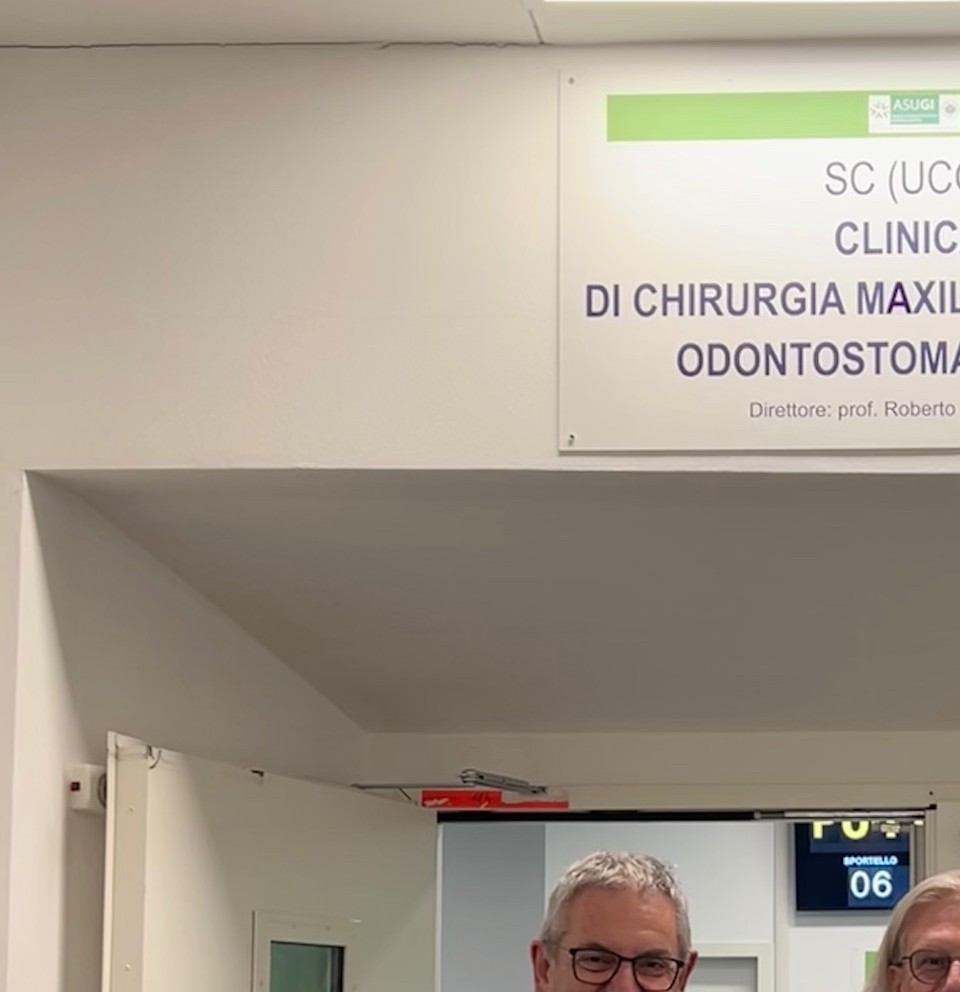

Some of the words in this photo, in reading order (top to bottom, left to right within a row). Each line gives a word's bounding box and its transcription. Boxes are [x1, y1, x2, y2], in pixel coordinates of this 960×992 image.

[893, 98, 935, 110] ASUGI
[824, 160, 876, 196] SC
[586, 283, 621, 319] DI
[633, 281, 847, 318] CHIRURGIA
[749, 400, 832, 418] Direttore:
[837, 399, 878, 421] prof.
[884, 398, 957, 417] Roberto
[843, 855, 898, 866] SPORTELLO
[850, 870, 893, 899] 06
